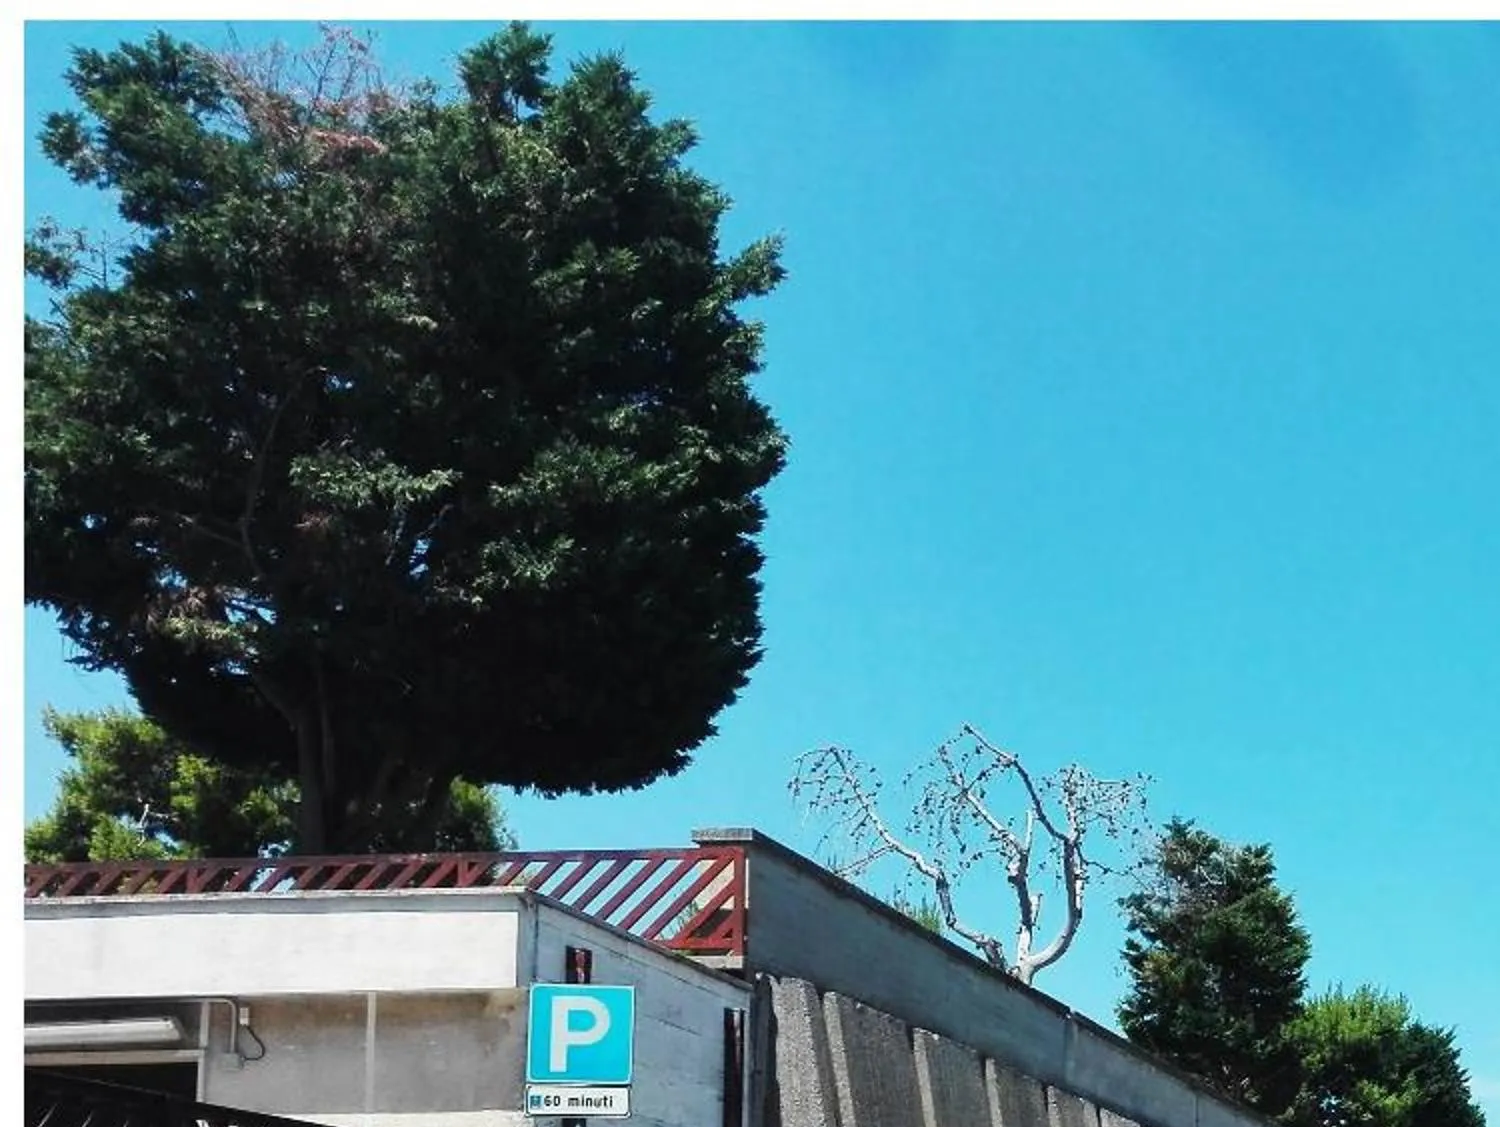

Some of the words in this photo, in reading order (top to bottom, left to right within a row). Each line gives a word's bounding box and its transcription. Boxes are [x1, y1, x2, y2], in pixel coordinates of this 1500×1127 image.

[550, 995, 611, 1072] P
[543, 1095, 561, 1107] 60
[567, 1094, 613, 1108] minuti
